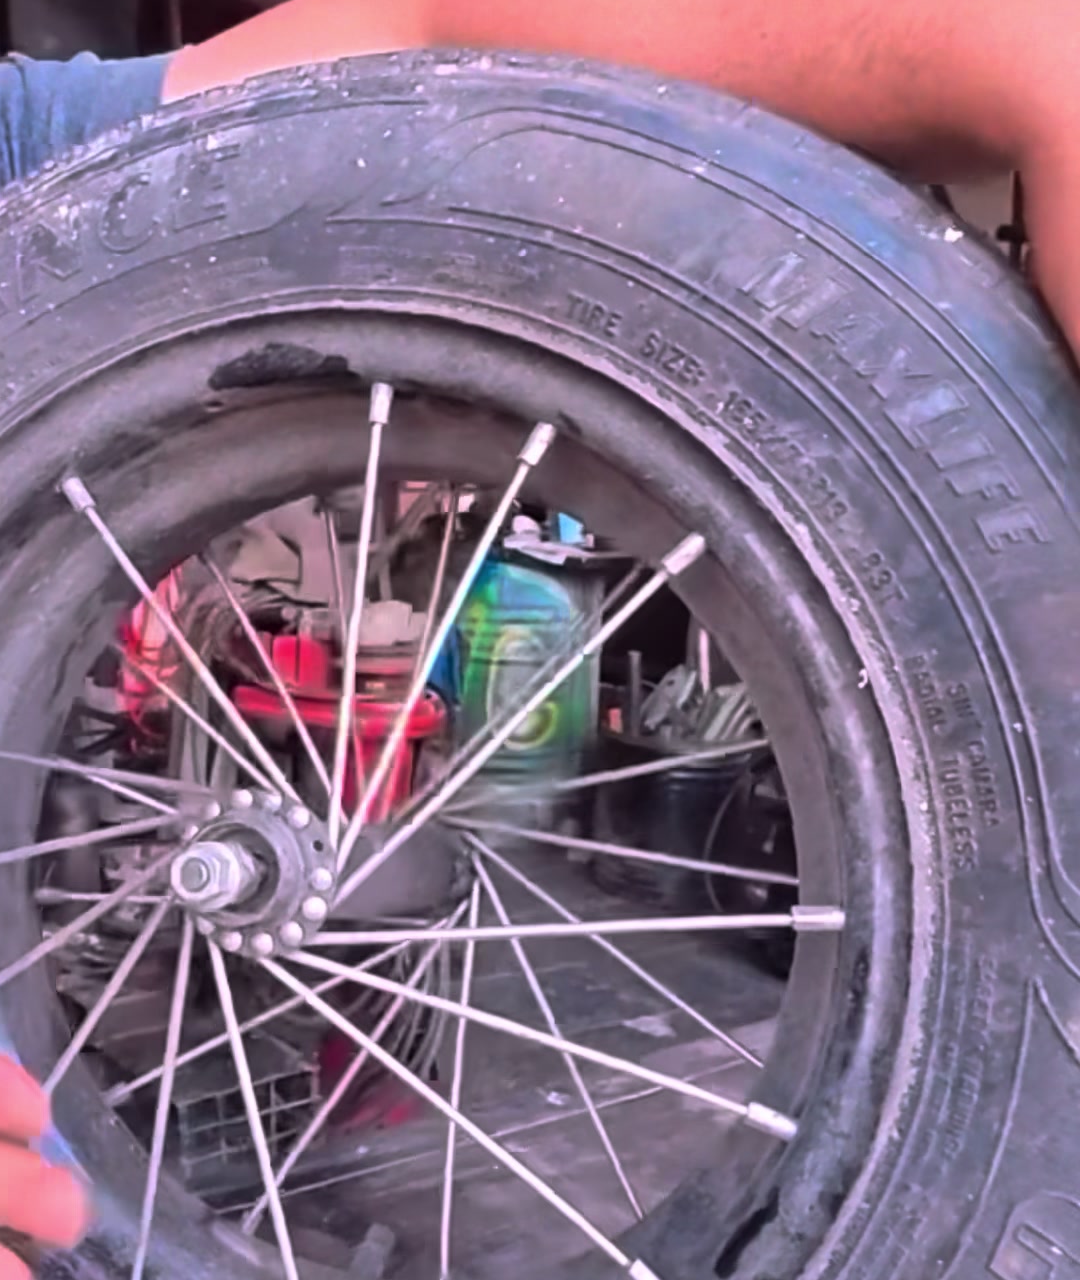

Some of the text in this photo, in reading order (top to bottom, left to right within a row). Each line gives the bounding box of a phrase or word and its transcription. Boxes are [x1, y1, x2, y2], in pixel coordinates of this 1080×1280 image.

[566, 295, 621, 339] TIRE
[739, 251, 1050, 552] MAXLIFE
[938, 754, 977, 872] TUBELESS
